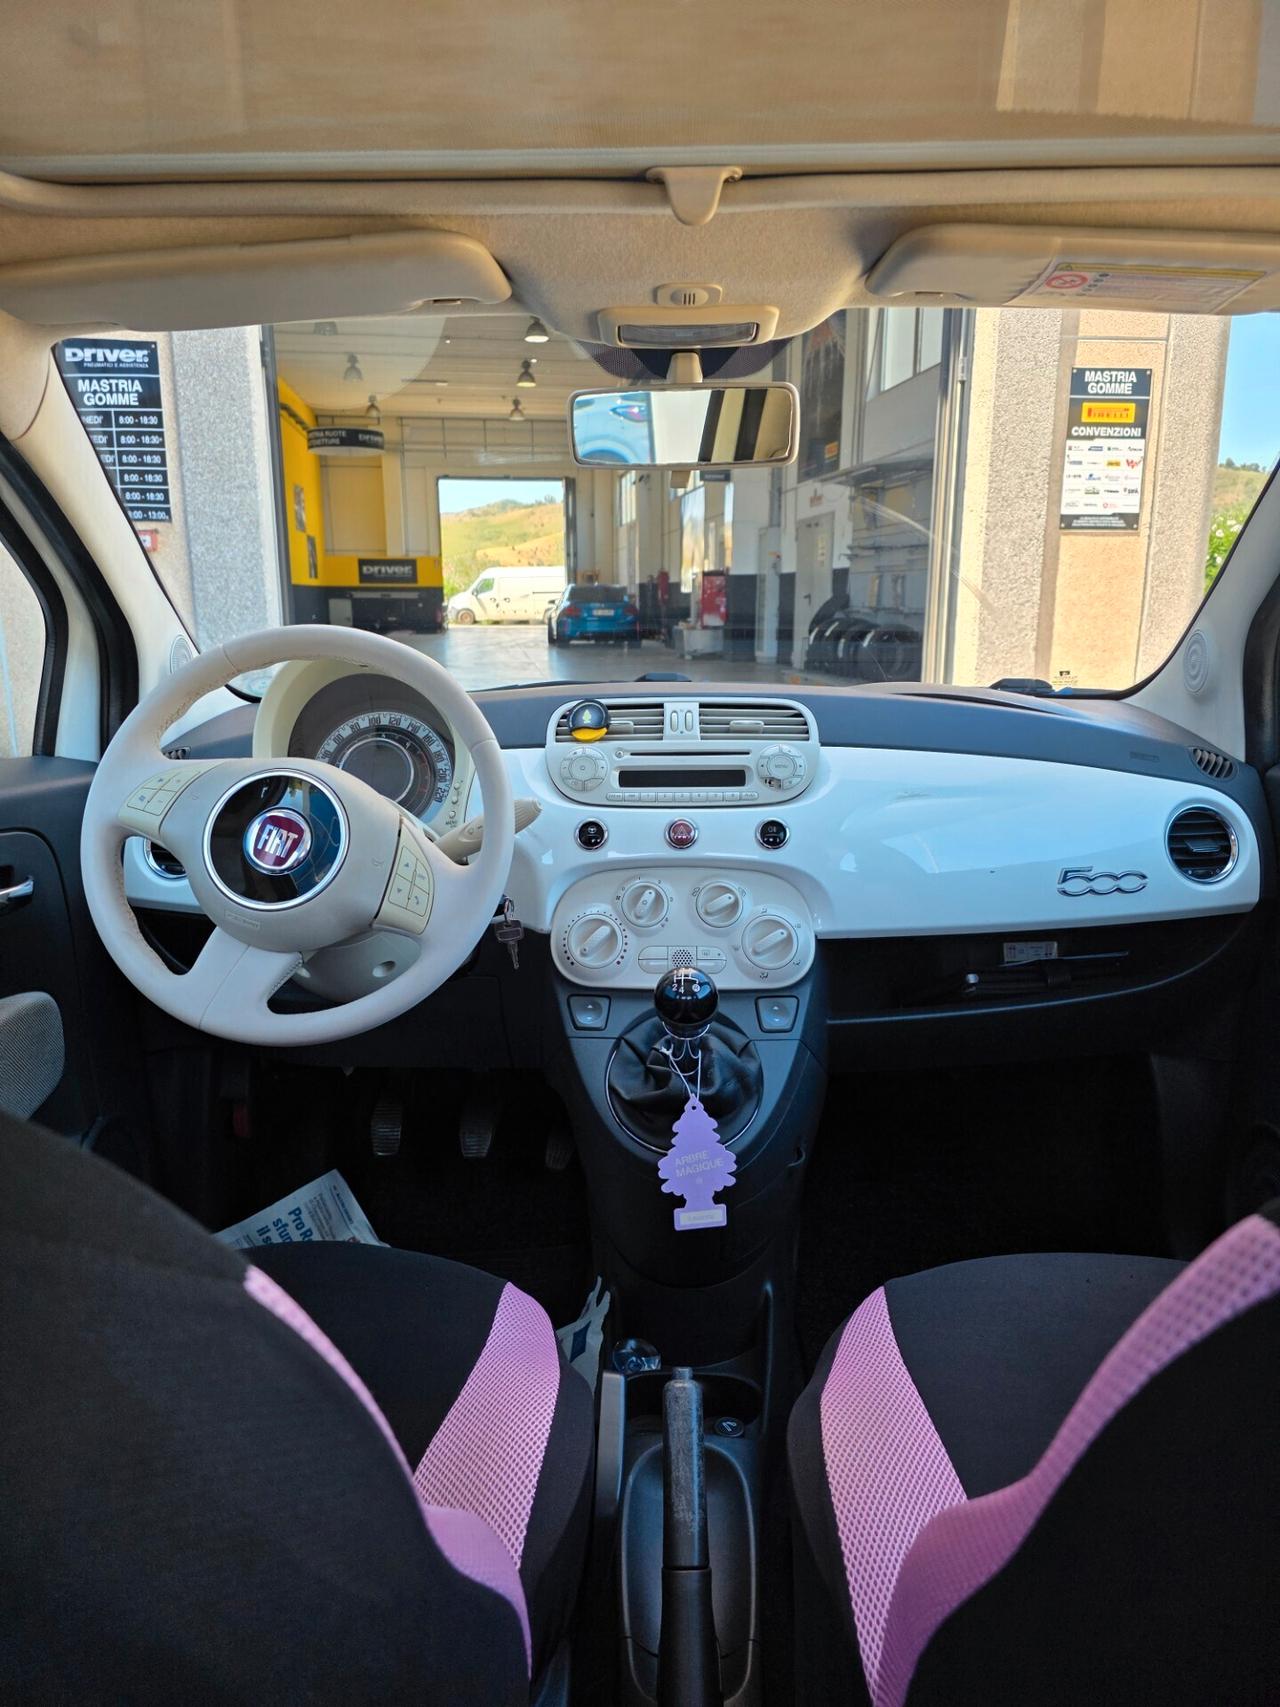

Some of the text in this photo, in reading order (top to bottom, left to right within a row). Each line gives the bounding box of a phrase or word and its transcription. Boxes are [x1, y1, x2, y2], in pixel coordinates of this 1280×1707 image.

[1084, 370, 1137, 383] MASTRIA
[77, 379, 143, 392] MASTRIA
[1087, 383, 1132, 395] GOMME
[83, 393, 139, 405] GOMME
[1071, 426, 1142, 437] CONVENZIONI
[368, 716, 381, 726] 100
[389, 716, 401, 726] 120
[437, 767, 449, 783] 200
[256, 824, 299, 858] FIAT
[1057, 866, 1148, 898] 500
[672, 983, 678, 991] 2
[675, 1158, 725, 1178] MAGIQUE
[288, 1206, 305, 1231] Pro
